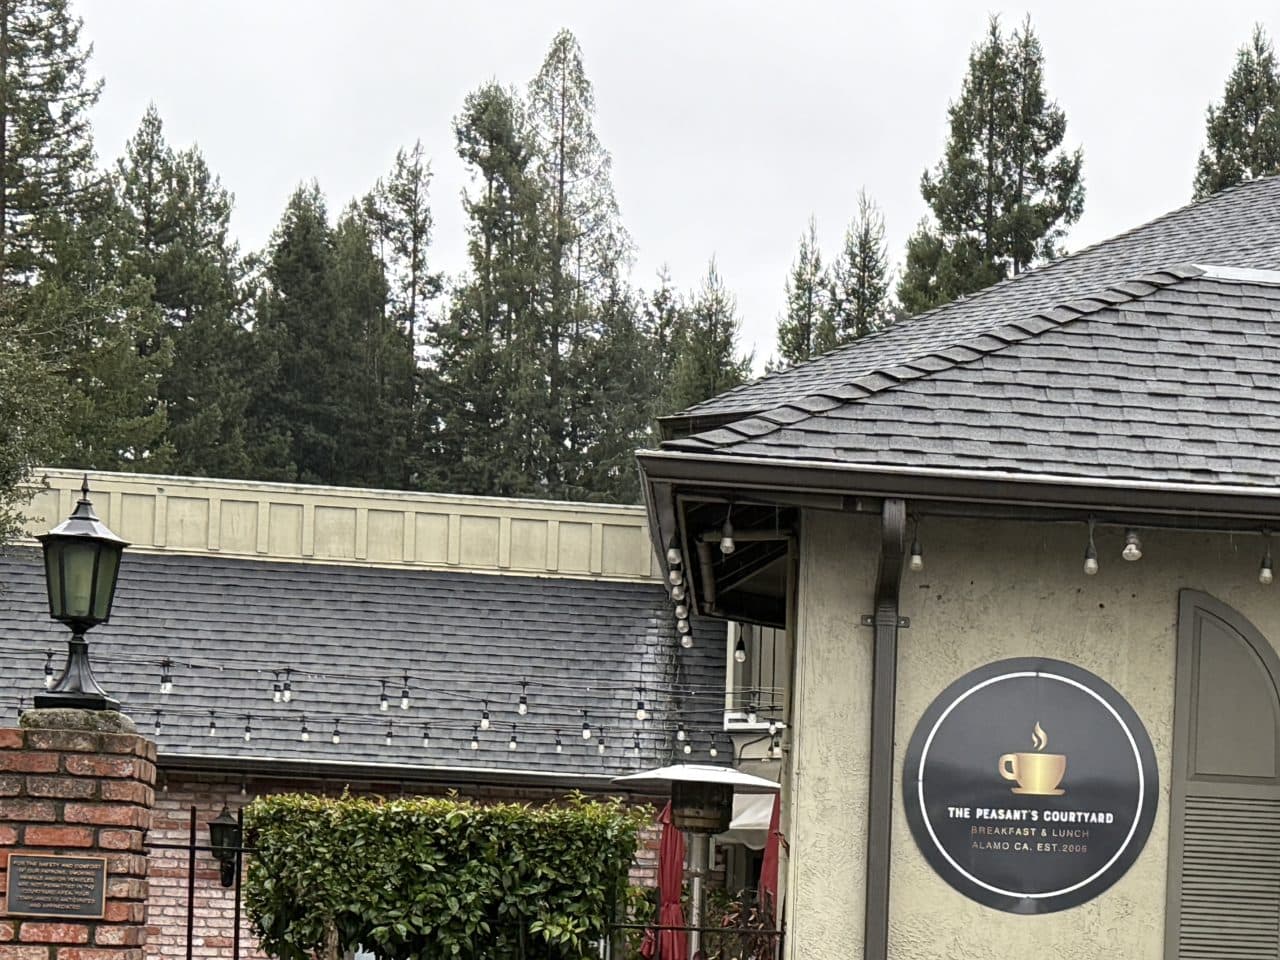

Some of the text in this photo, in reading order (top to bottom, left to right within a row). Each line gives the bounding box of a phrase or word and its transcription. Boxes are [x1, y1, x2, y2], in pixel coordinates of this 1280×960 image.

[948, 807, 1114, 824] THE PEASANT'S COURTYARD
[971, 825, 1089, 838] BREAKFAST & LUNCH
[971, 841, 1010, 850] ALAMO
